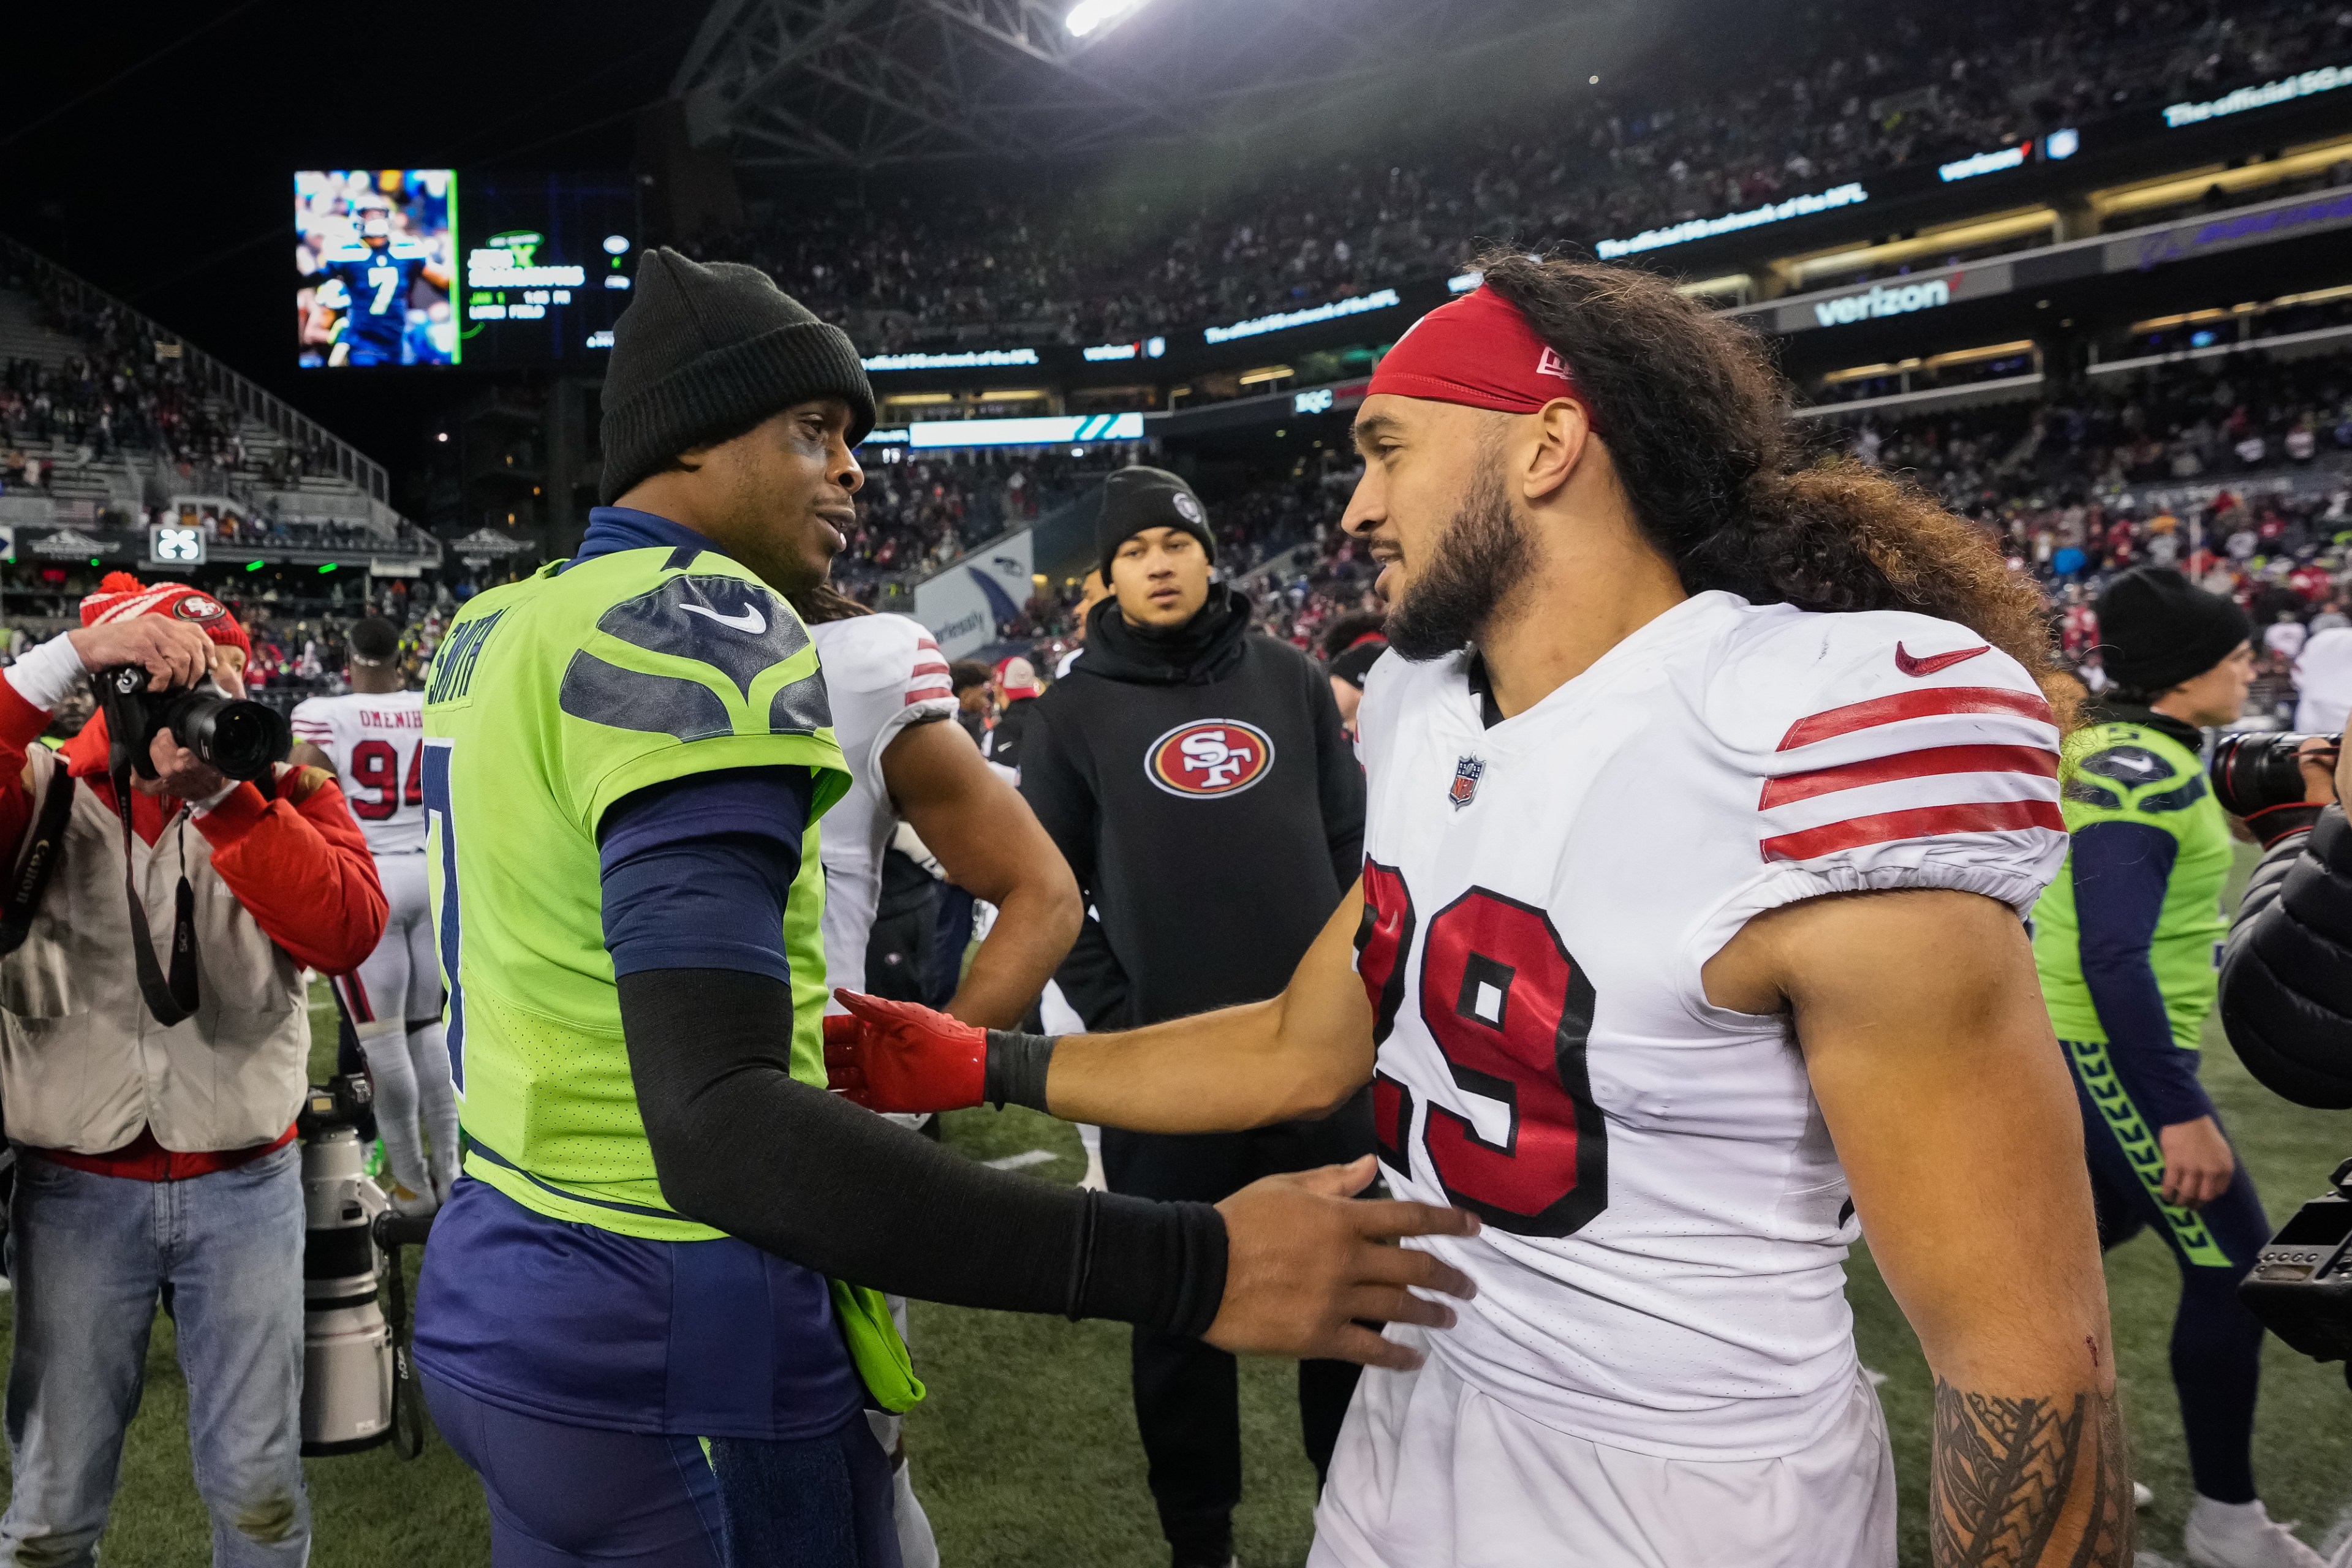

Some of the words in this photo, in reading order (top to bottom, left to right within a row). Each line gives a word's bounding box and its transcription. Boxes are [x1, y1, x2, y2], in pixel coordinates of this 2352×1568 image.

[2162, 102, 2211, 127] The
[2211, 75, 2297, 118] official
[2297, 66, 2339, 96] 5G
[368, 267, 399, 315] 7
[1815, 279, 1950, 327] verizon
[158, 529, 199, 560] 25
[427, 605, 512, 705] SMITH
[360, 710, 423, 729] OMENIH
[1180, 730, 1252, 788] SF
[16, 839, 50, 903] Canon
